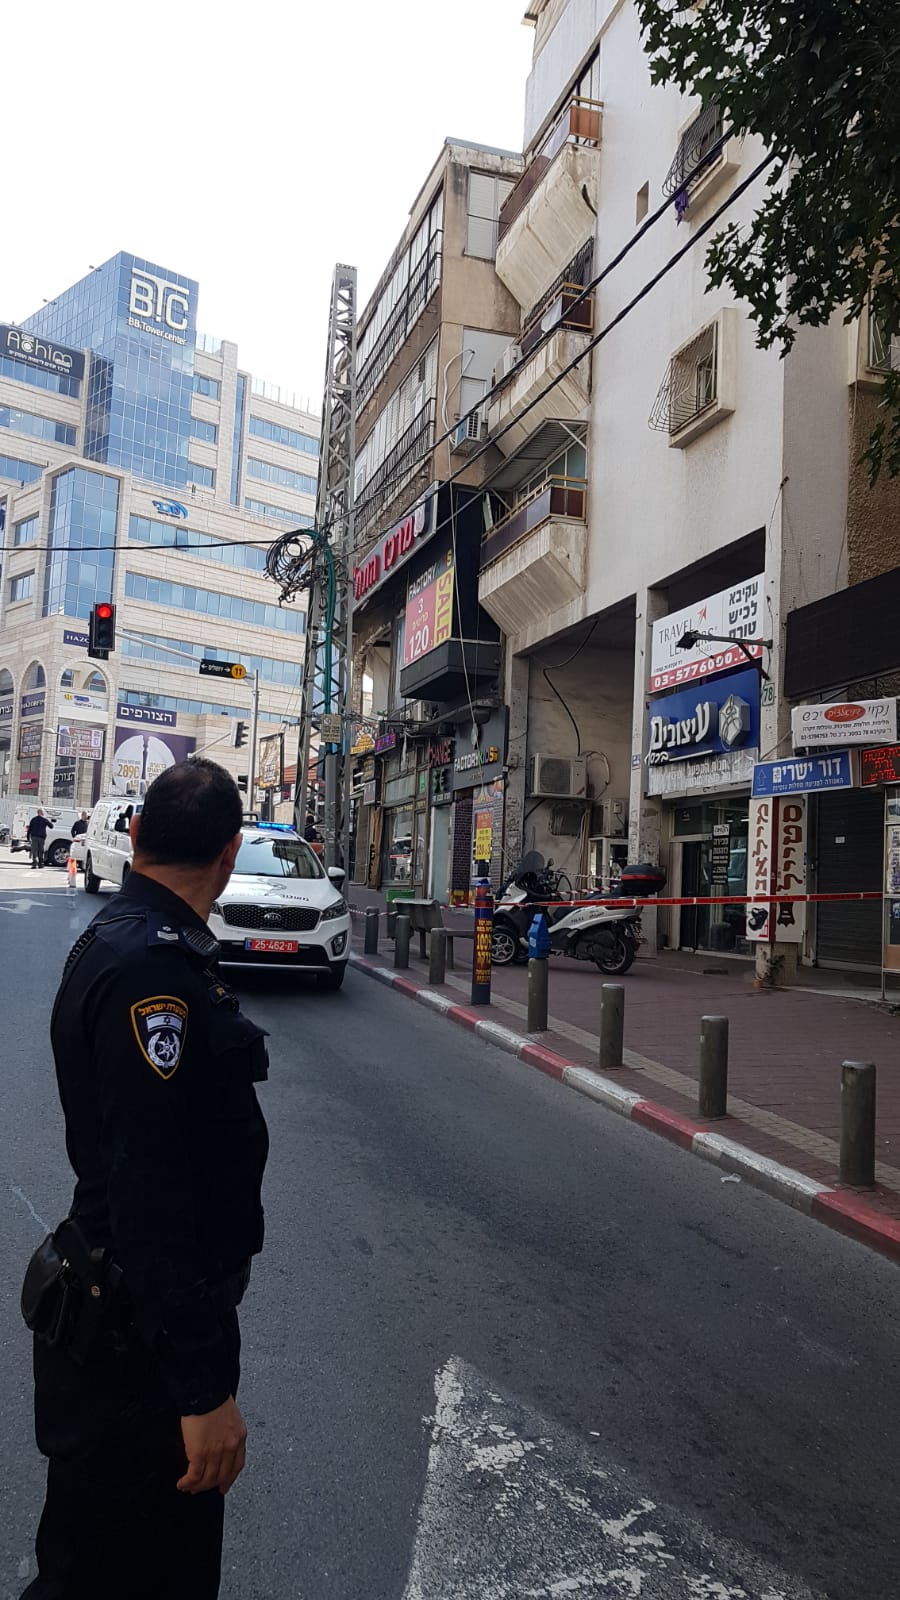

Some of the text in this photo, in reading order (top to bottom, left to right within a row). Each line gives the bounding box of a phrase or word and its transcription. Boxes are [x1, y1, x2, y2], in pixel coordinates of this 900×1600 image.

[130, 268, 190, 330] BTC
[7, 330, 73, 368] Achim
[728, 581, 759, 607] עקיבא
[436, 573, 452, 643] SALE
[728, 600, 758, 625] לכיש
[409, 624, 430, 659] 120
[658, 618, 694, 645] TRAVEL
[234, 667, 242, 676] 11
[763, 685, 773, 702] 78
[120, 706, 173, 722] הצורפים
[650, 701, 711, 752] עיצובים
[772, 758, 842, 784] דור ישרים
